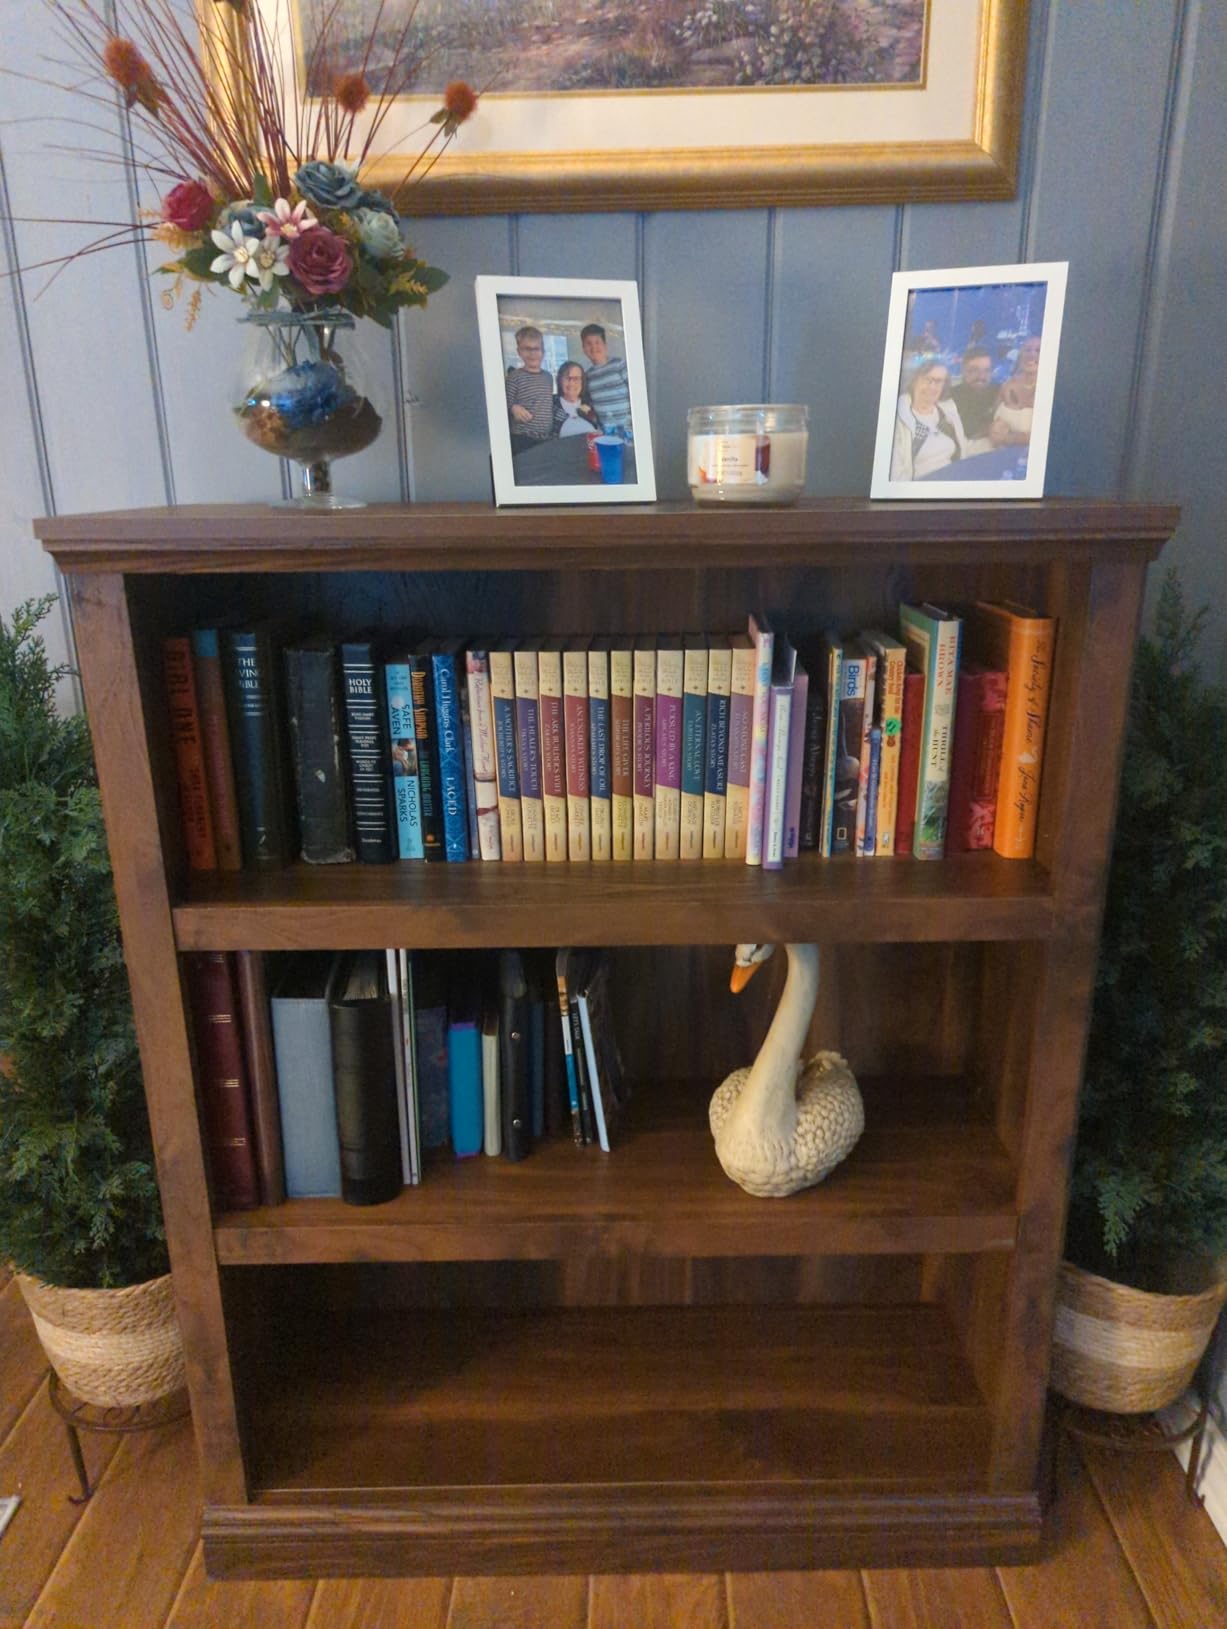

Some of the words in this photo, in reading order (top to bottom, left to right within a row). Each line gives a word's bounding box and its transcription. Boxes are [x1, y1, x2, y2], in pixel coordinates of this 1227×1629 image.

[948, 634, 956, 666] RITA
[440, 668, 452, 693] Carol
[847, 664, 860, 697] Birds
[936, 644, 946, 688] BROWN
[349, 679, 373, 688] HOLY
[350, 686, 373, 694] BIBLE
[944, 669, 954, 696] MAE
[401, 703, 412, 729] SAFE
[414, 708, 429, 740] SIMPSON
[528, 708, 536, 722] THE
[598, 706, 606, 722] THE
[718, 700, 727, 719] RICH
[598, 722, 606, 742] LAST
[718, 720, 726, 754] BEYOND
[940, 725, 949, 764] THRILL
[598, 744, 606, 765] DROP
[930, 739, 939, 769] HUNT
[578, 758, 586, 792] WITNESS
[598, 766, 606, 776] OF
[644, 753, 652, 788] JOURNEY
[716, 755, 726, 791] MEASURE
[398, 787, 408, 823] SPARKS
[407, 779, 418, 827] NICHOLAS
[446, 776, 457, 816] LACED
